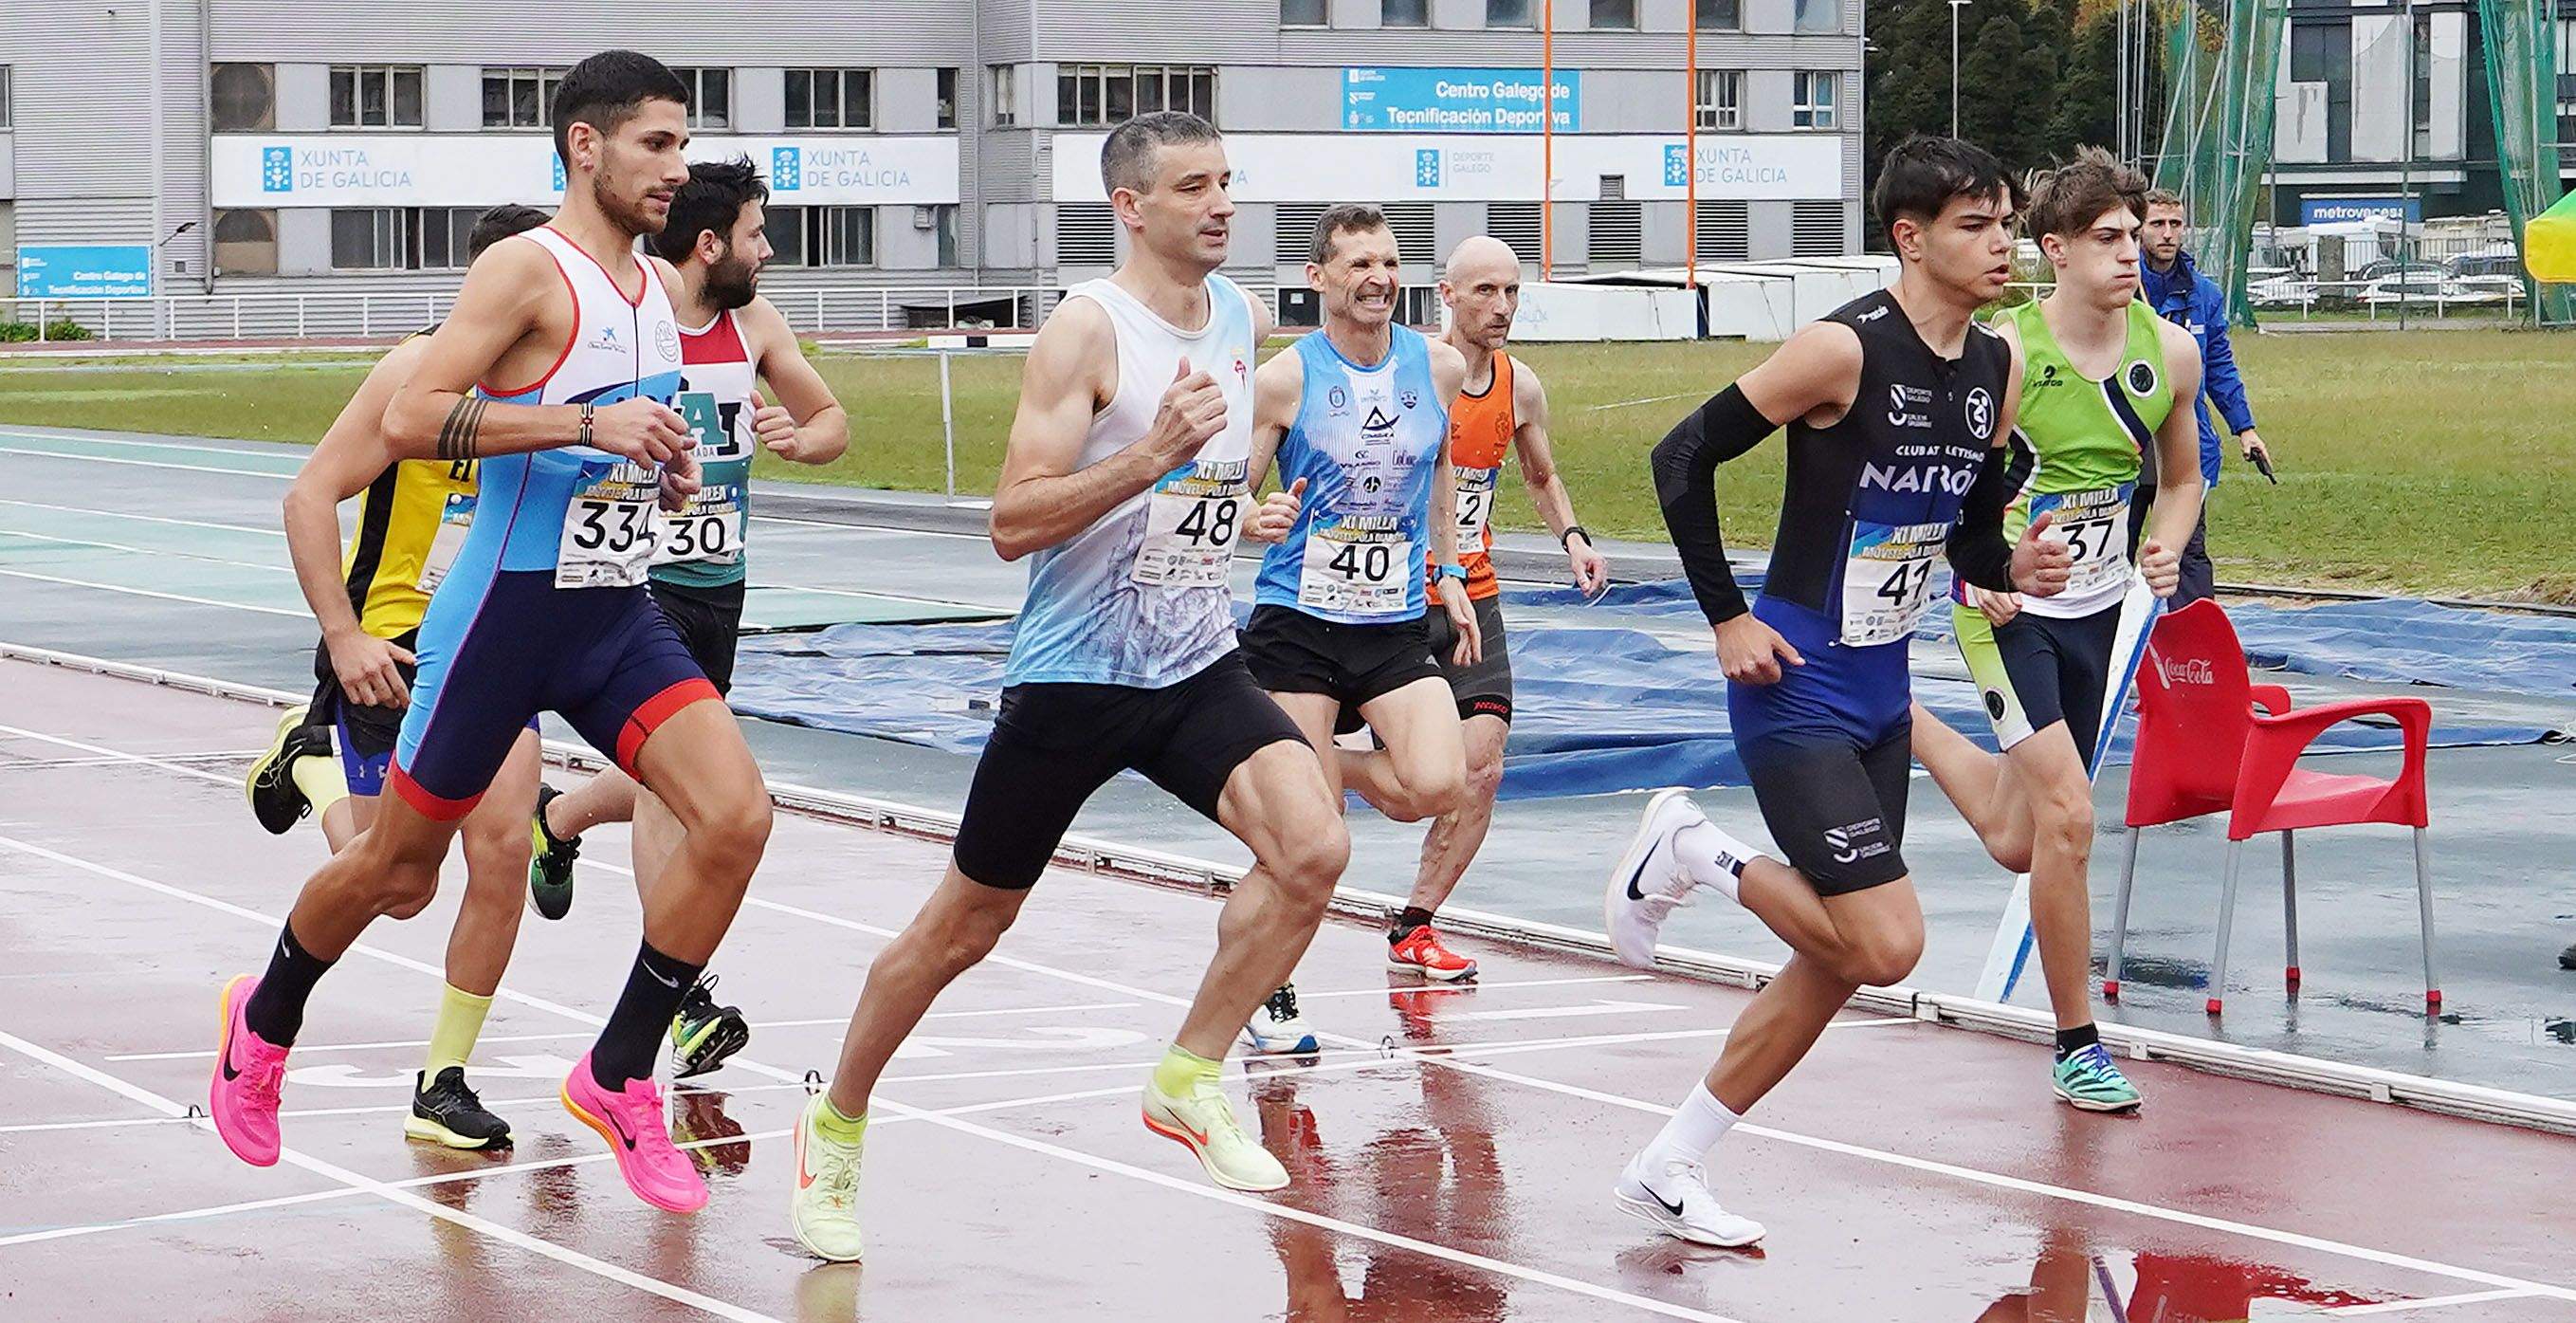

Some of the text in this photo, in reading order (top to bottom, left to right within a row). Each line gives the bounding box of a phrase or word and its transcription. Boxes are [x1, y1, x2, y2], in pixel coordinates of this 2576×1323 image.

[1435, 81, 1489, 99] Centro
[1551, 83, 1570, 99] de
[1387, 106, 1492, 124] Tecnificación
[1495, 108, 1570, 126] Deportva
[301, 150, 369, 167] XUNTA
[808, 150, 871, 167] XUNTA
[1696, 148, 1752, 164] XUNTA
[1452, 164, 1492, 174] GALEGO
[1695, 168, 1787, 183] DE GALICIA
[300, 171, 412, 188] DE GALICIA
[807, 171, 910, 187] DE GALICIA
[1895, 445, 1926, 455] CLUB
[1196, 461, 1213, 479] XI
[2062, 487, 2119, 509] XI MILLA
[1455, 494, 1481, 525] 2
[573, 501, 657, 552] 334
[1176, 501, 1237, 546] 48
[1342, 514, 1398, 531] XI MILLA
[667, 517, 725, 556] 30
[1891, 526, 1908, 543] XI
[2061, 517, 2114, 562] 37
[1329, 544, 1390, 581] 40
[1877, 559, 1932, 606] 41
